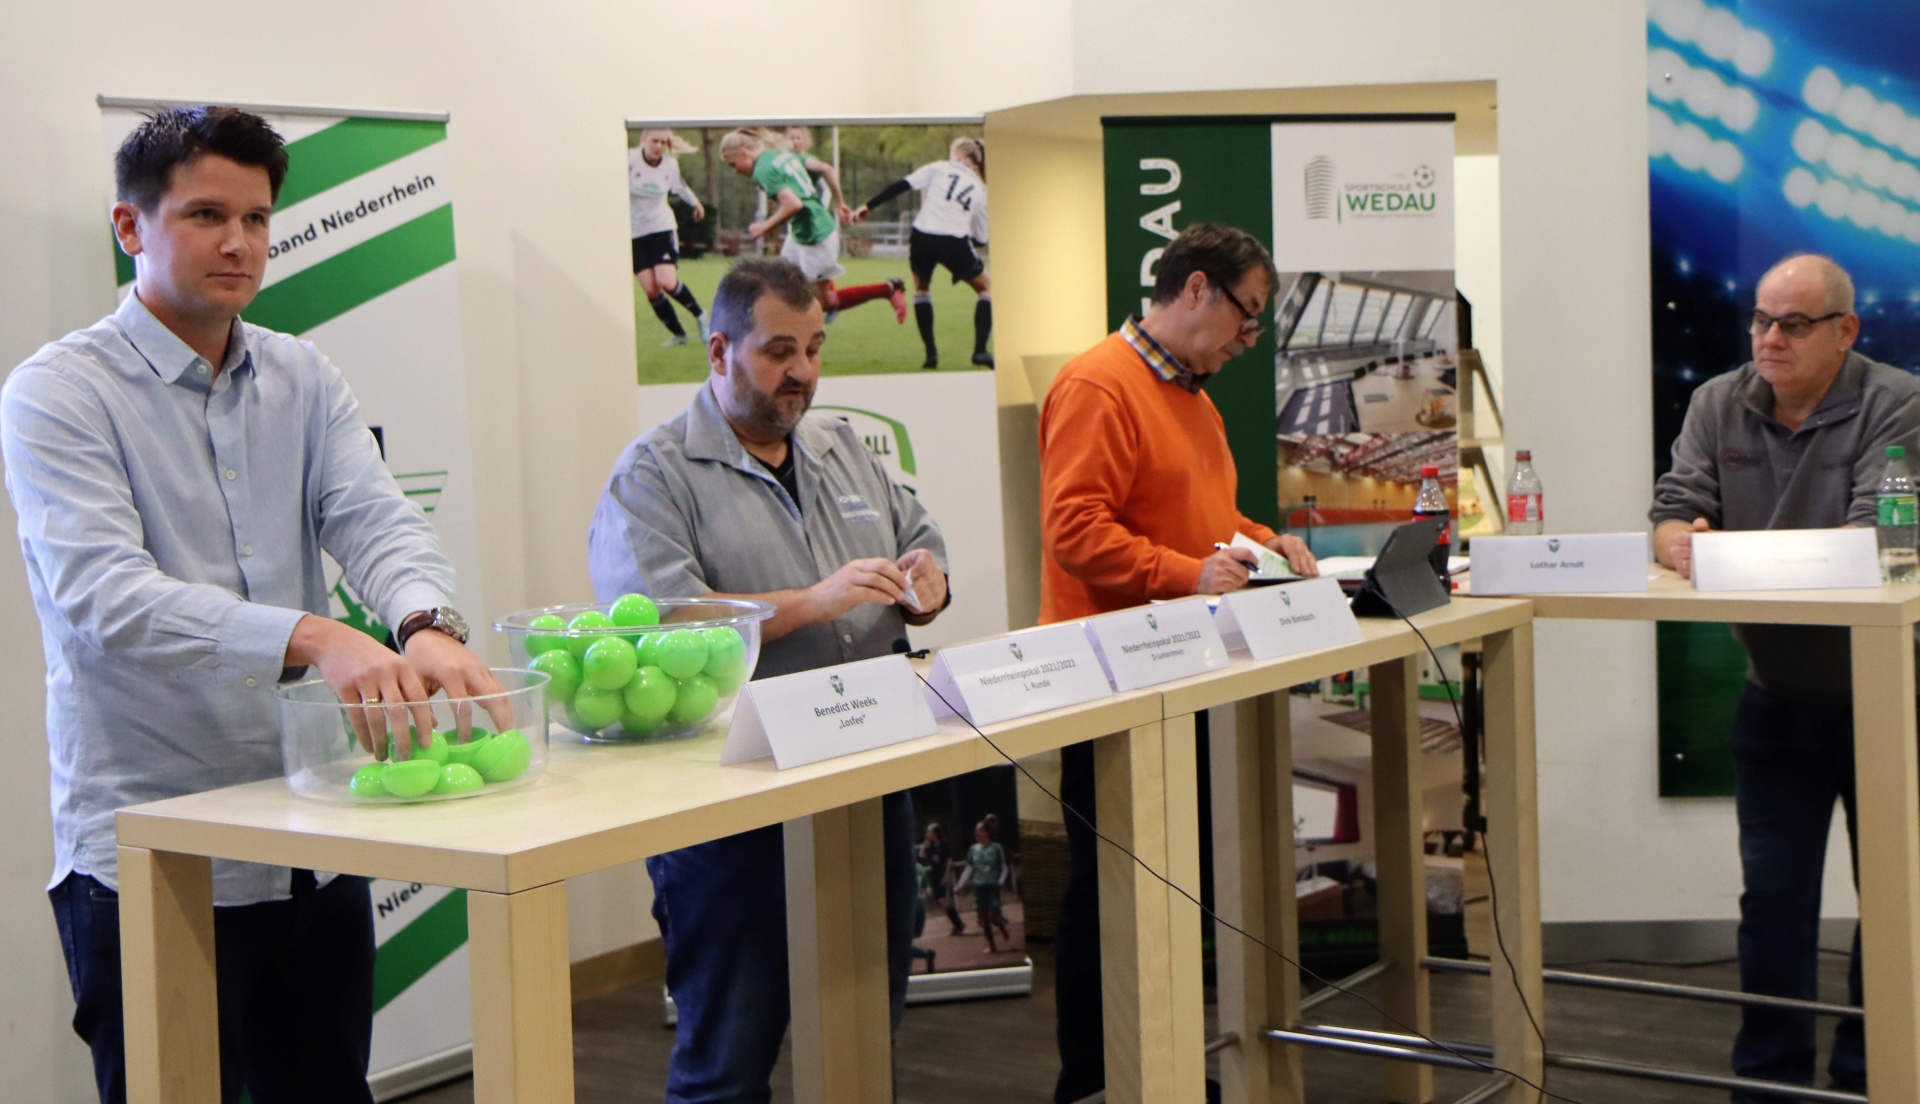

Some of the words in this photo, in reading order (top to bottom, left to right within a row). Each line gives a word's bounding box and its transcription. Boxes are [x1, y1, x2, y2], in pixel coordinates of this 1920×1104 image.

[947, 174, 976, 211] 14
[1346, 192, 1436, 212] WEDAU
[320, 174, 436, 234] Niederrhein
[1530, 561, 1558, 569] Lothar
[1559, 560, 1585, 569] Arndt
[1121, 636, 1172, 654] Niederrheinpokal
[979, 667, 1041, 687] Niederrheinpokal
[1040, 658, 1077, 674] 2021/2022
[1031, 678, 1052, 690] Runde
[813, 702, 851, 717] Benedict
[849, 696, 878, 710] Weeks
